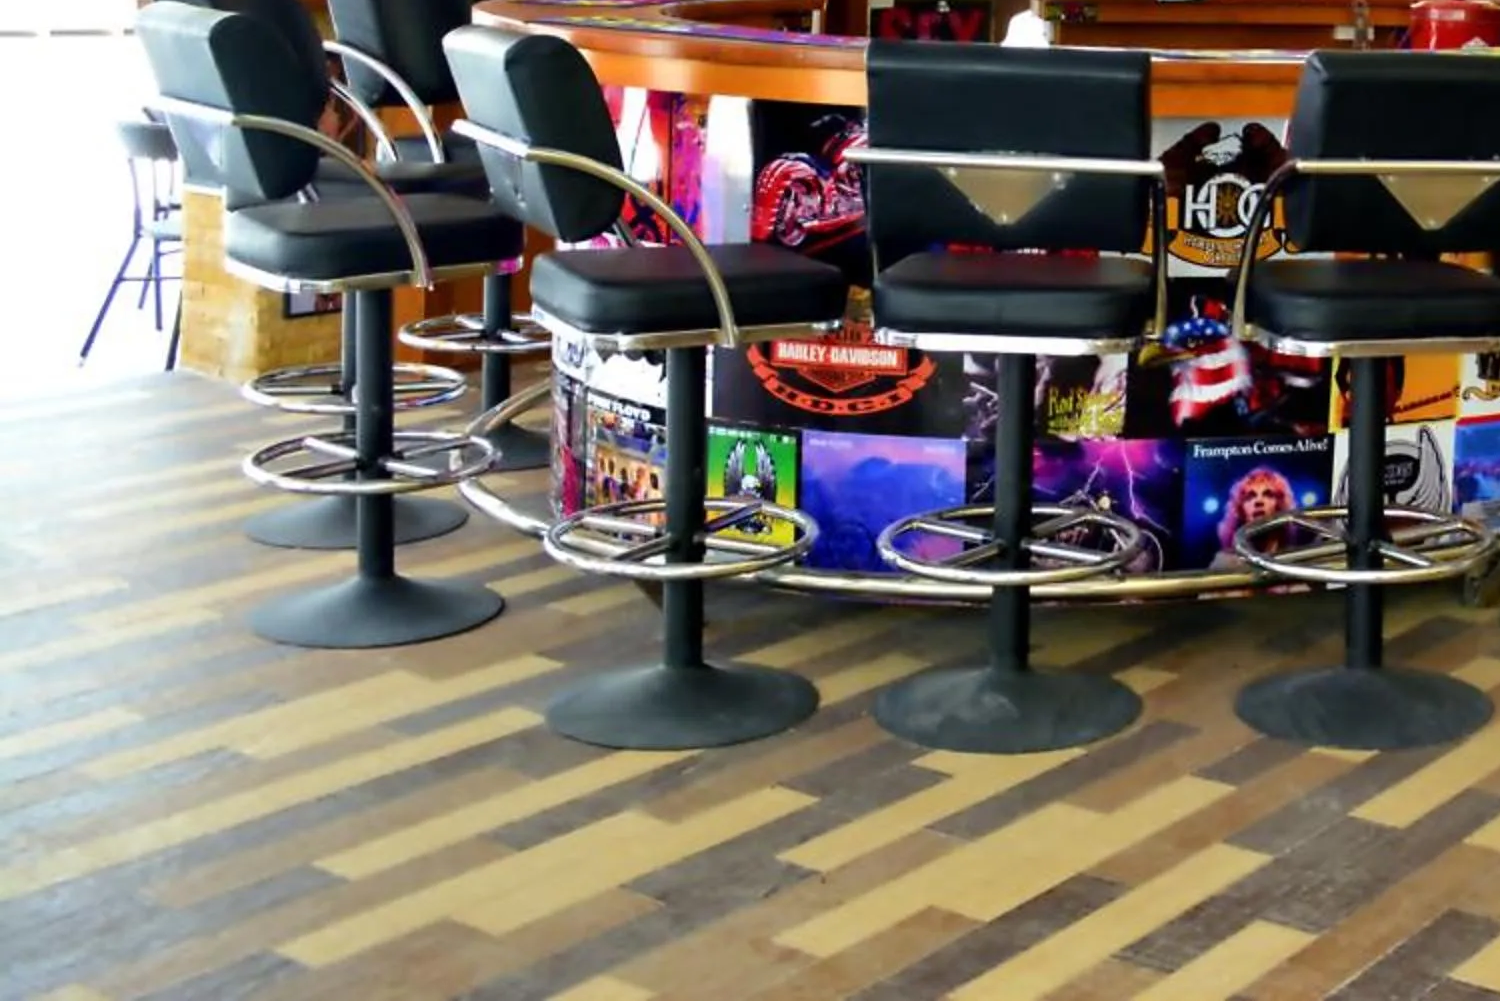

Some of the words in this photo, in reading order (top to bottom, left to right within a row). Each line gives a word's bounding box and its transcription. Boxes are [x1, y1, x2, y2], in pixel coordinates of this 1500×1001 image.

[611, 398, 651, 421] FLOYD
[1193, 444, 1252, 460] Frampton
[1253, 440, 1293, 455] Comes
[1294, 438, 1328, 453] Alive!
